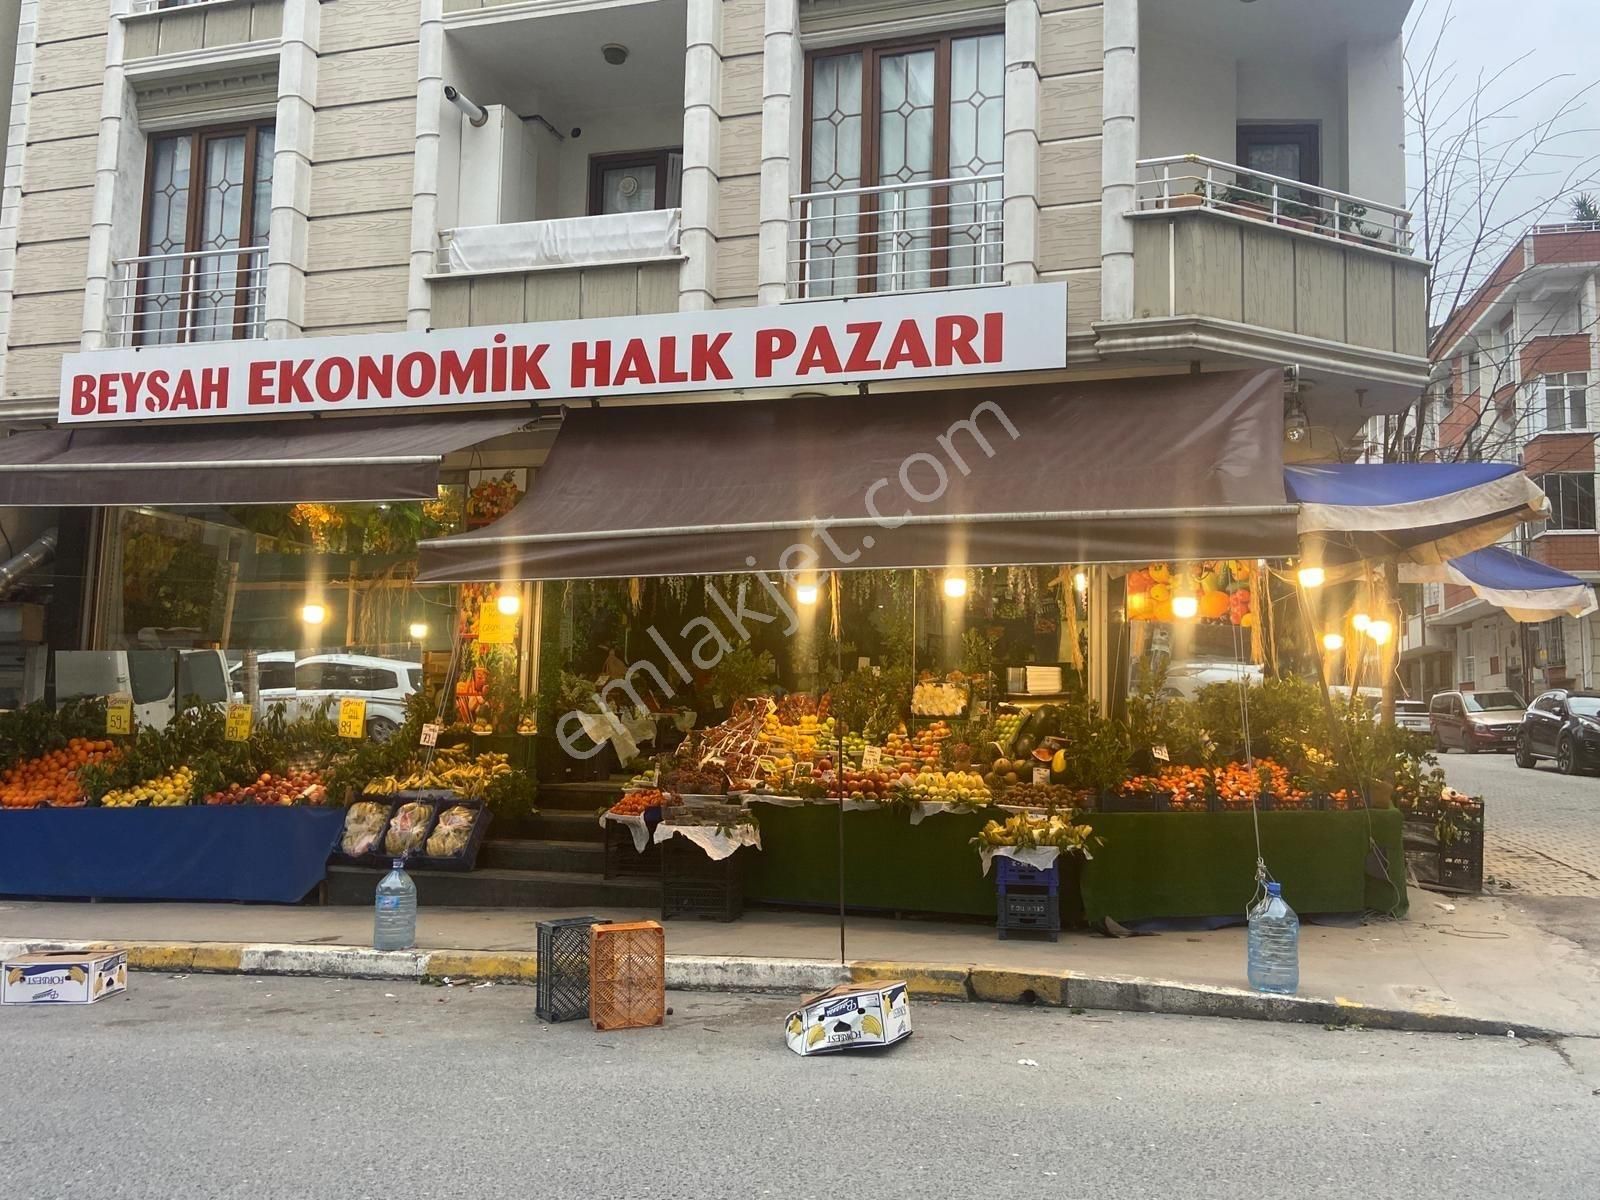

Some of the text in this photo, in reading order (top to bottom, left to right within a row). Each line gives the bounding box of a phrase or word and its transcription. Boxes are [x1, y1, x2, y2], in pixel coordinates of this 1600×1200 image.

[248, 334, 550, 405] EKONOMİK
[570, 332, 733, 387] HALK
[755, 313, 1003, 378] PAZARI
[26, 975, 65, 985] FORBEST
